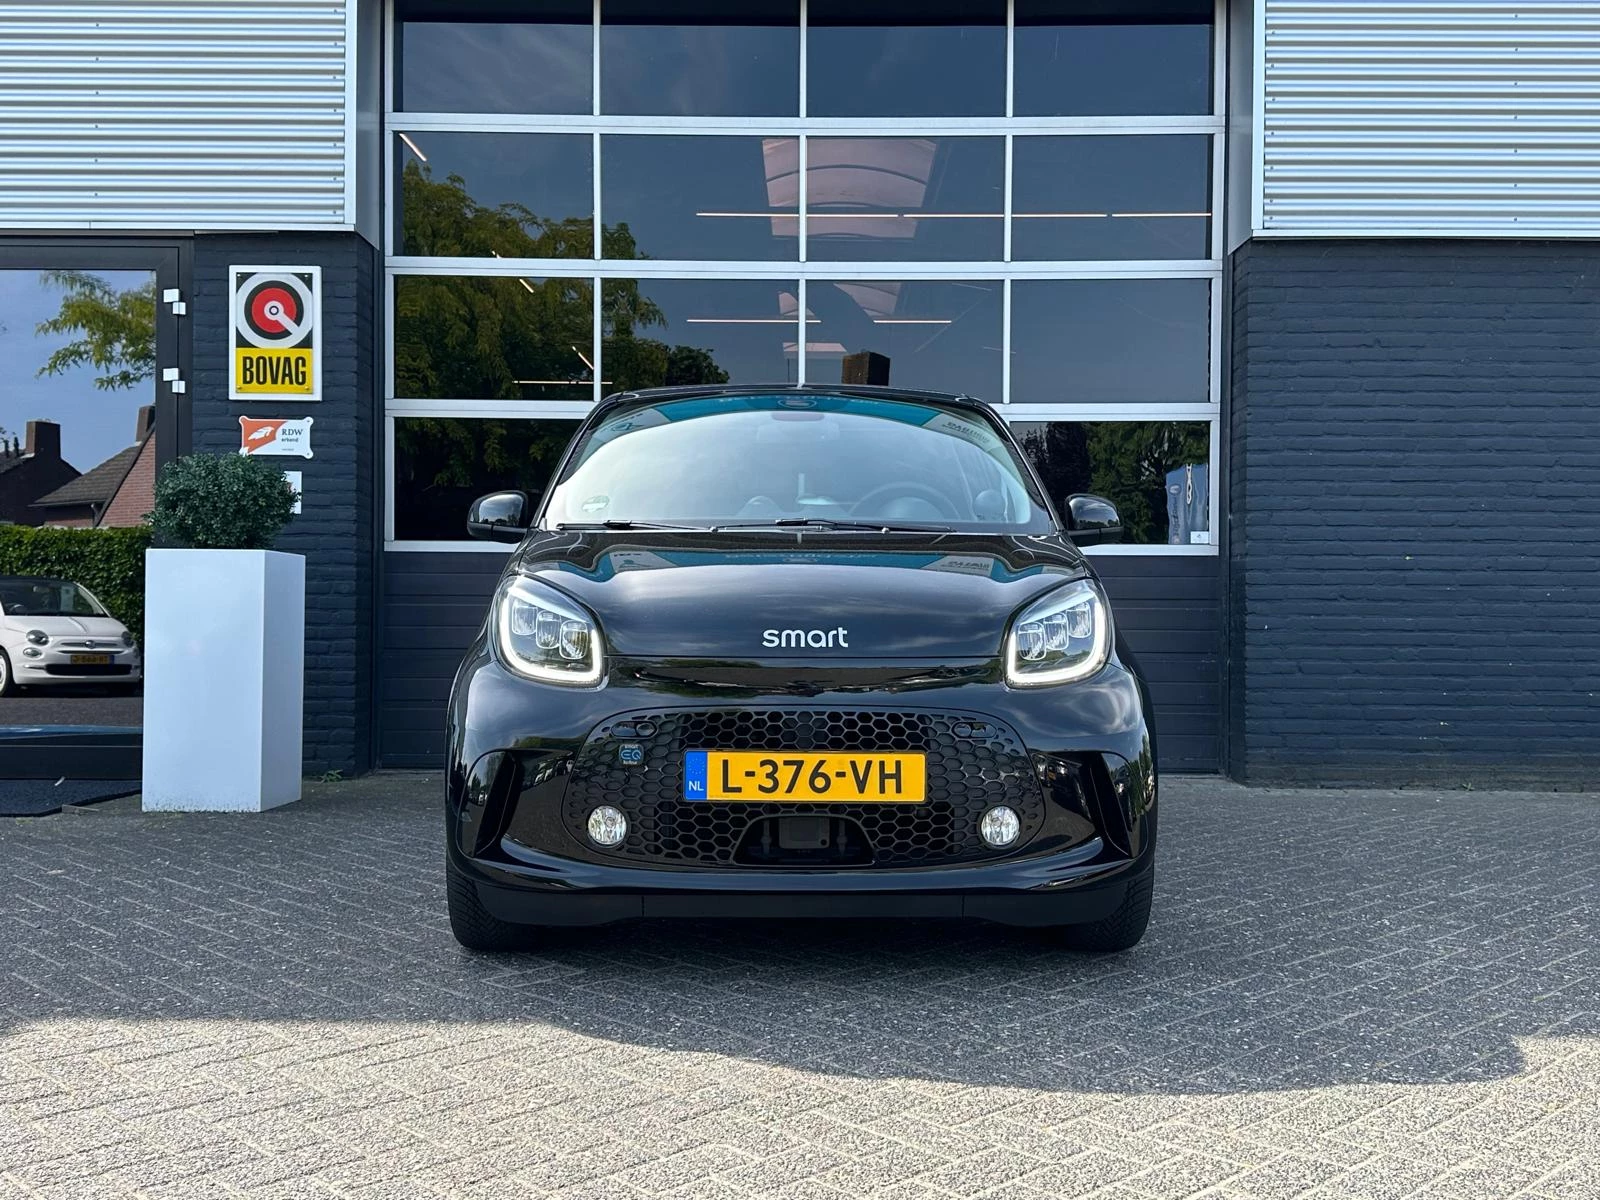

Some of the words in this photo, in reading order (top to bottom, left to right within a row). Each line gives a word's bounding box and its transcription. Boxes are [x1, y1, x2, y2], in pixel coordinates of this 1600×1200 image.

[242, 356, 307, 385] BOVAG
[281, 428, 303, 436] RDW
[761, 627, 849, 648] smart
[620, 749, 641, 760] EQ
[722, 759, 902, 794] L-376-VH
[688, 780, 705, 791] NL
